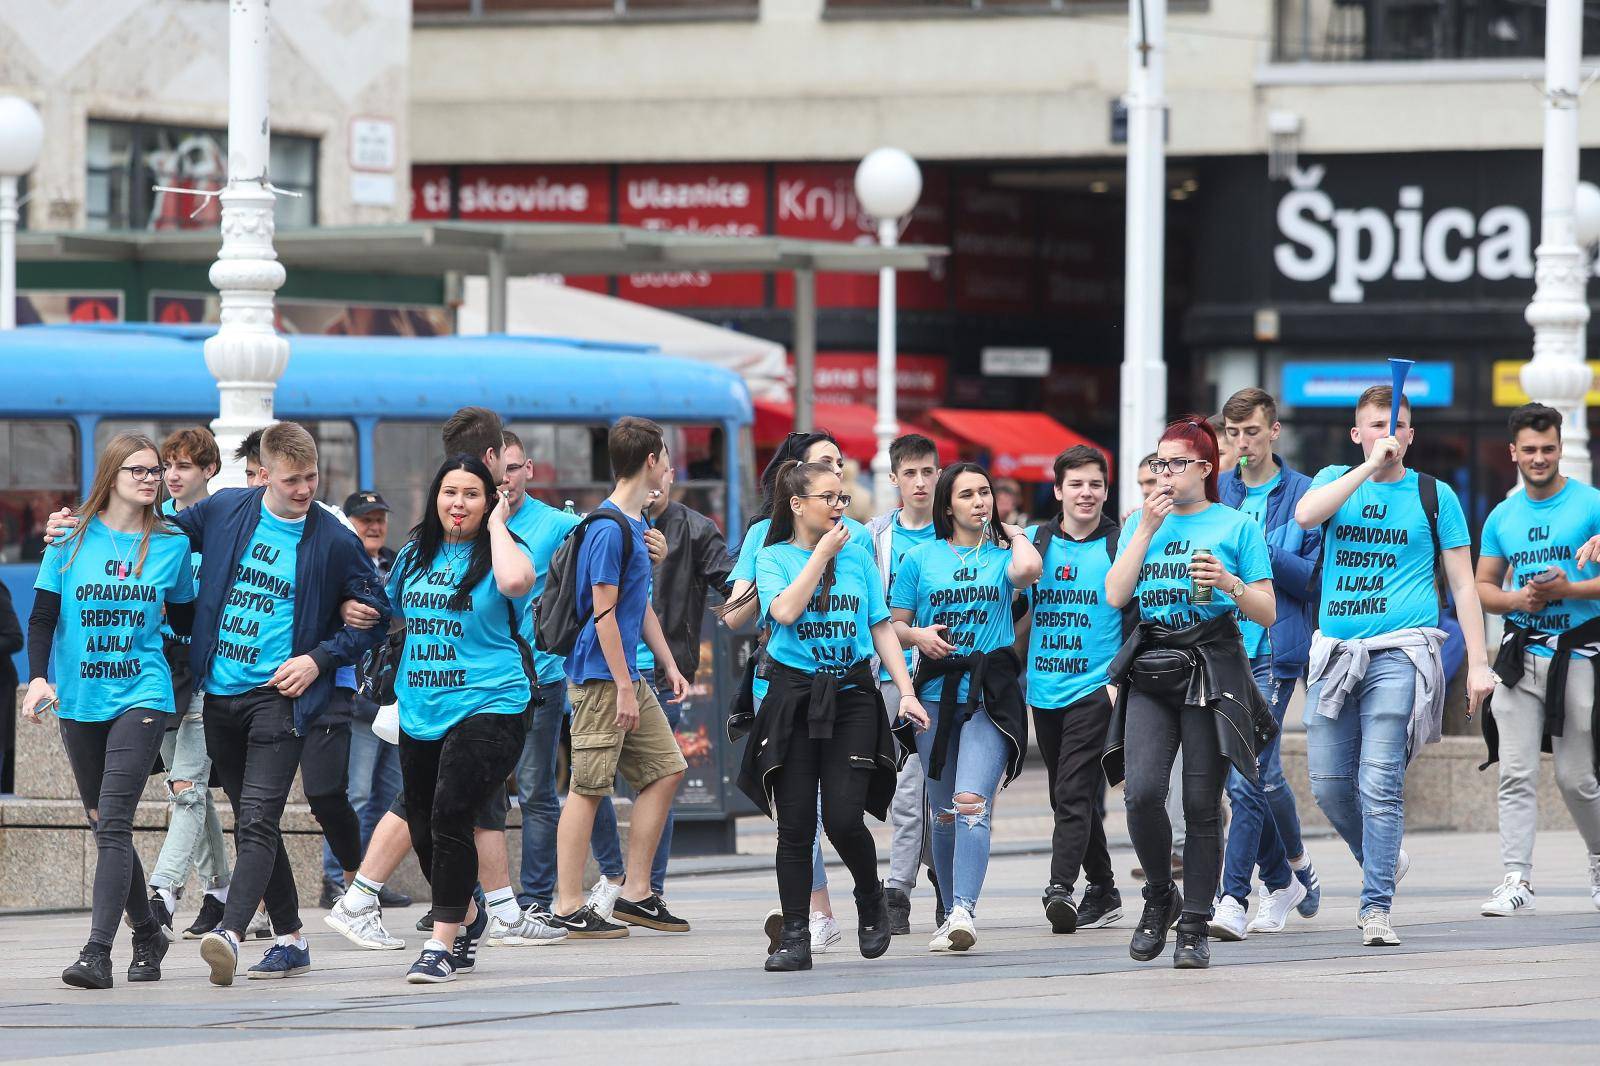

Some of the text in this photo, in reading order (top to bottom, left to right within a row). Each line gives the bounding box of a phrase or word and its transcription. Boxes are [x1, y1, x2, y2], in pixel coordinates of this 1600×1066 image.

[628, 177, 750, 209] Ulaznice
[1274, 164, 1535, 303] Špica
[1362, 504, 1388, 520] CILJ
[1335, 525, 1408, 545] OPRAVDAVA
[1528, 525, 1550, 542] CILJ
[252, 543, 281, 565] CILJ
[1164, 540, 1190, 556] CILJ
[1335, 550, 1397, 569] SREDSTVO,
[1336, 576, 1343, 591] A
[76, 584, 157, 602] OPRAVDAVA
[929, 585, 999, 607] OPRAVDAVA
[1032, 589, 1098, 605] OPRAVDAVA
[1035, 612, 1091, 629] SREDSTVO,
[86, 635, 95, 652] A
[1041, 635, 1082, 650] A LJILJA
[410, 644, 457, 661] A LJILJA
